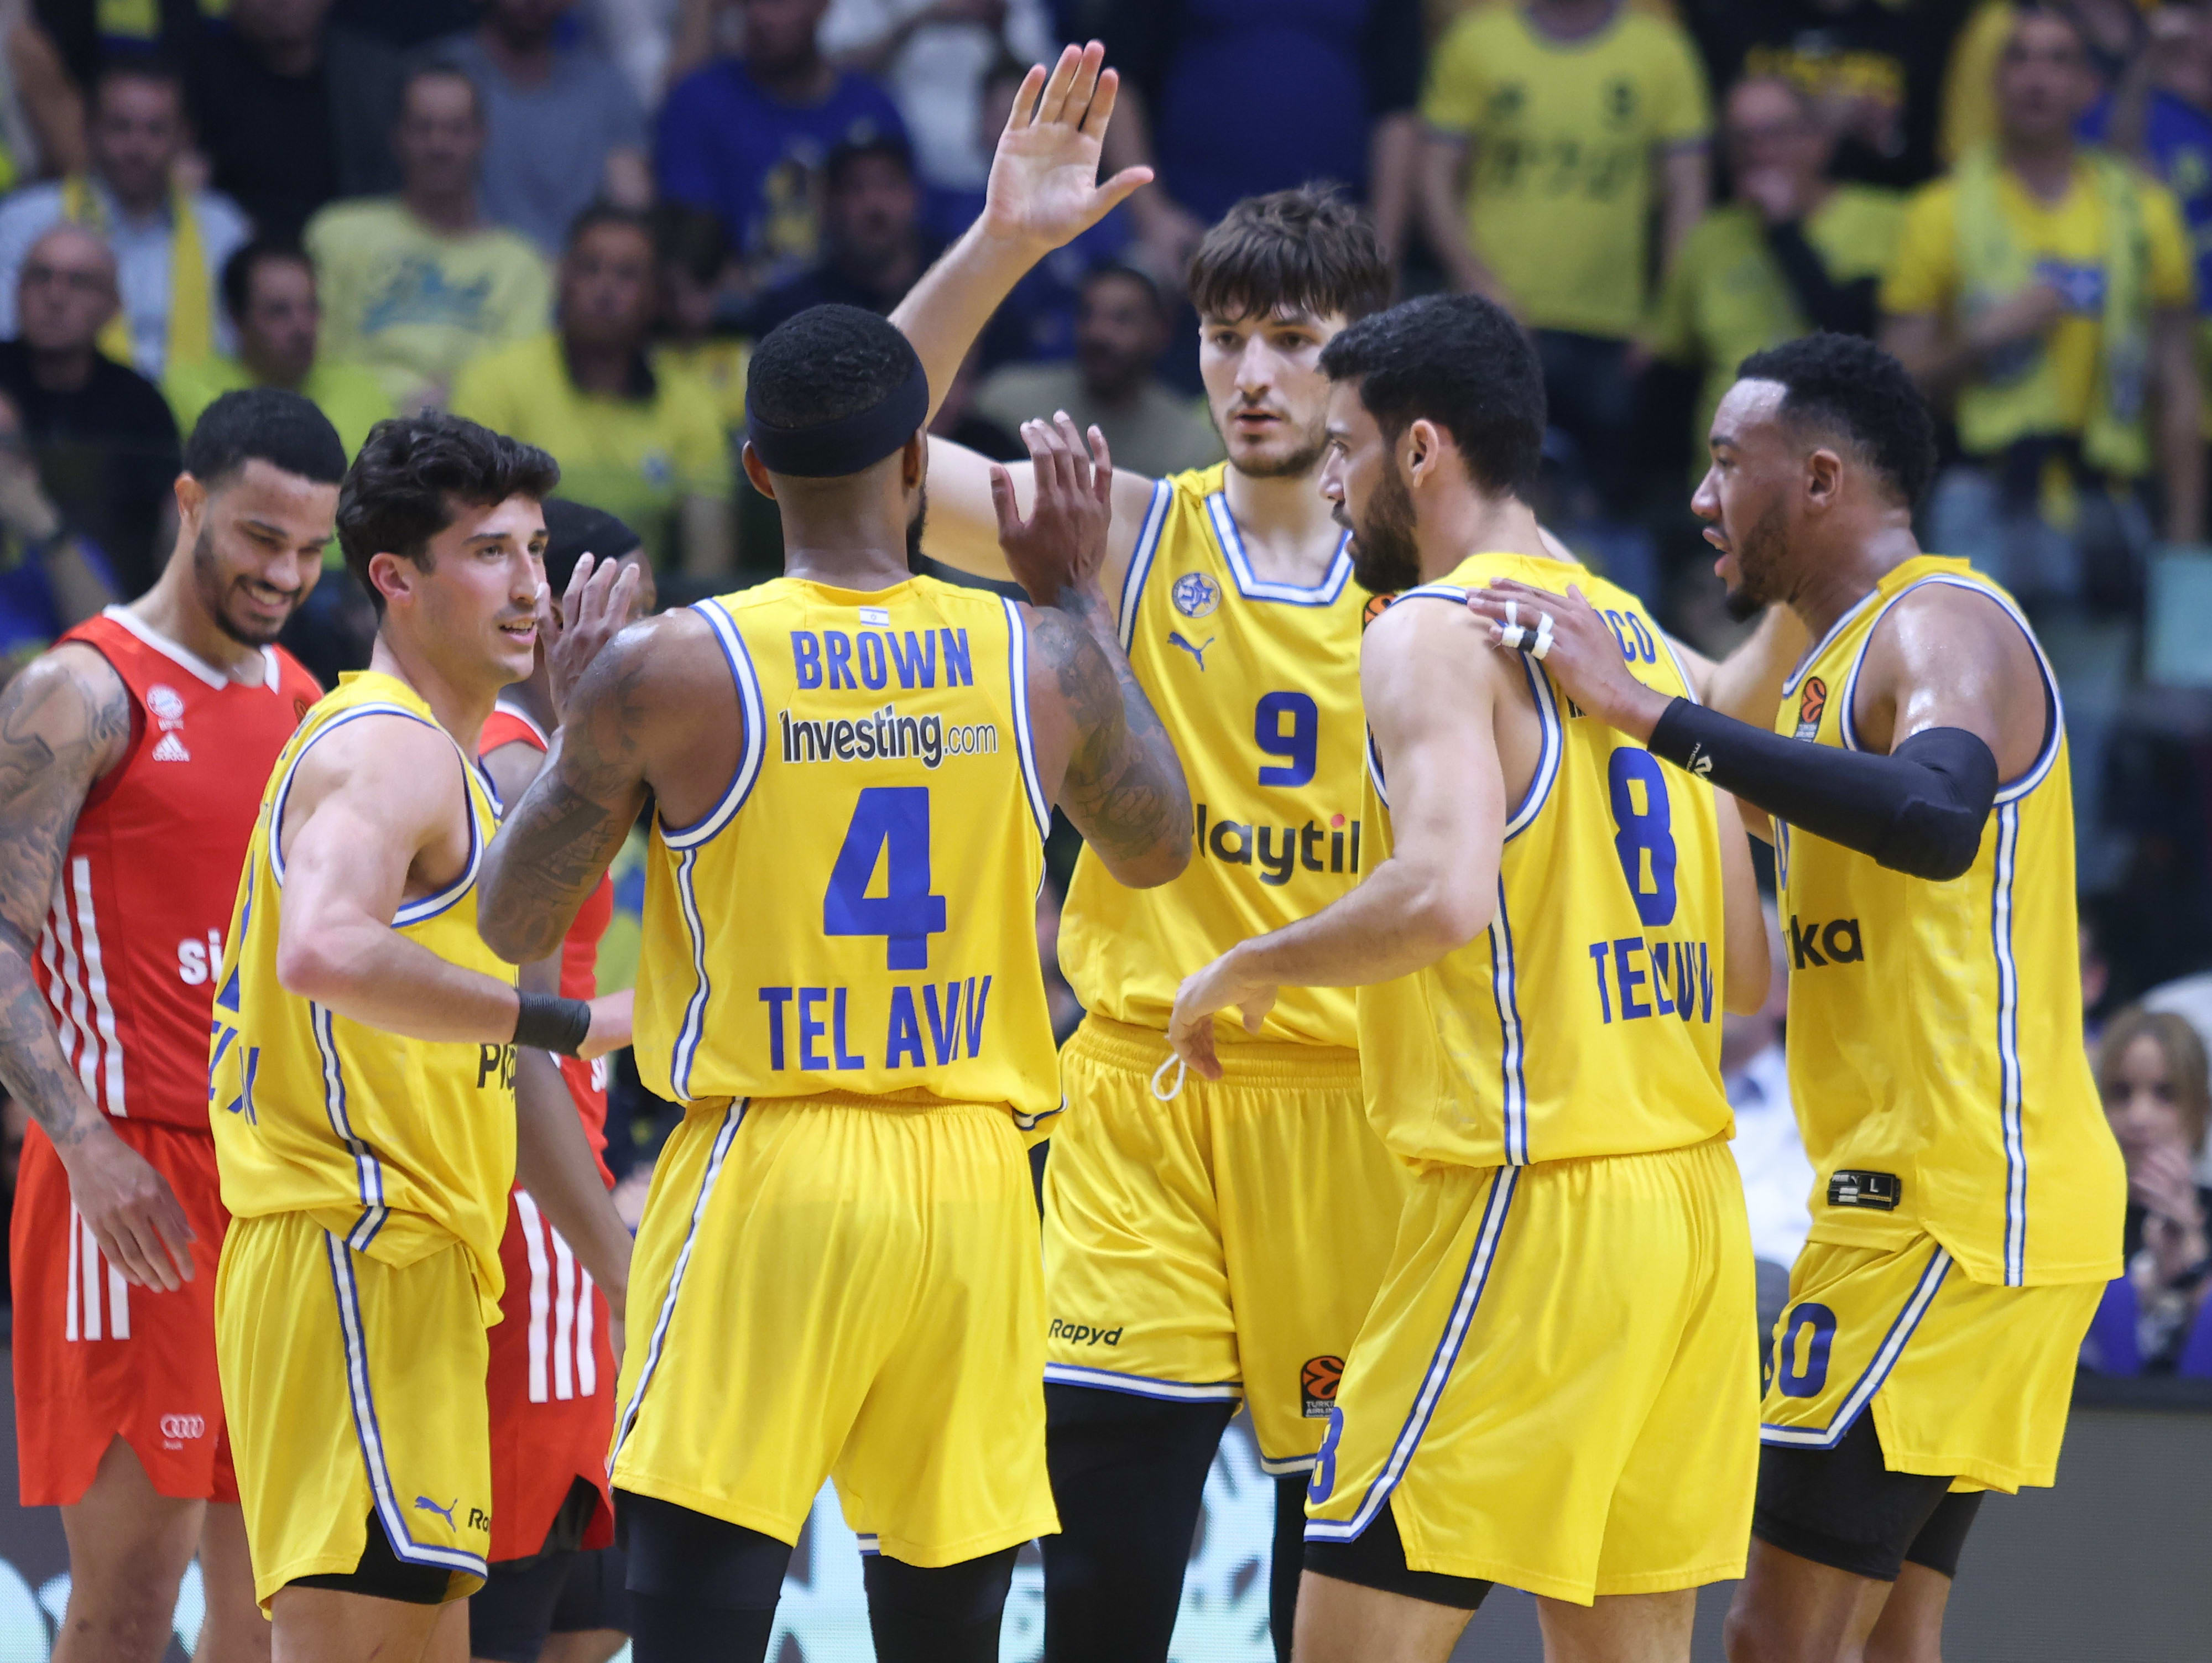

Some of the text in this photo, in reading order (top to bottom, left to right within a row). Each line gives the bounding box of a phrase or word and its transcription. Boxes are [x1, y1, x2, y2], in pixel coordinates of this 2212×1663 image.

[790, 628, 973, 691] BROWN
[1592, 609, 1656, 664] CO
[778, 703, 999, 769] Investing.com
[1254, 691, 1318, 787] 9
[1608, 747, 1677, 927] 8
[823, 786, 946, 971] 4
[1784, 914, 1864, 969] ka
[758, 975, 992, 1071] TEL AVV
[1048, 1318, 1124, 1346] Rapyd
